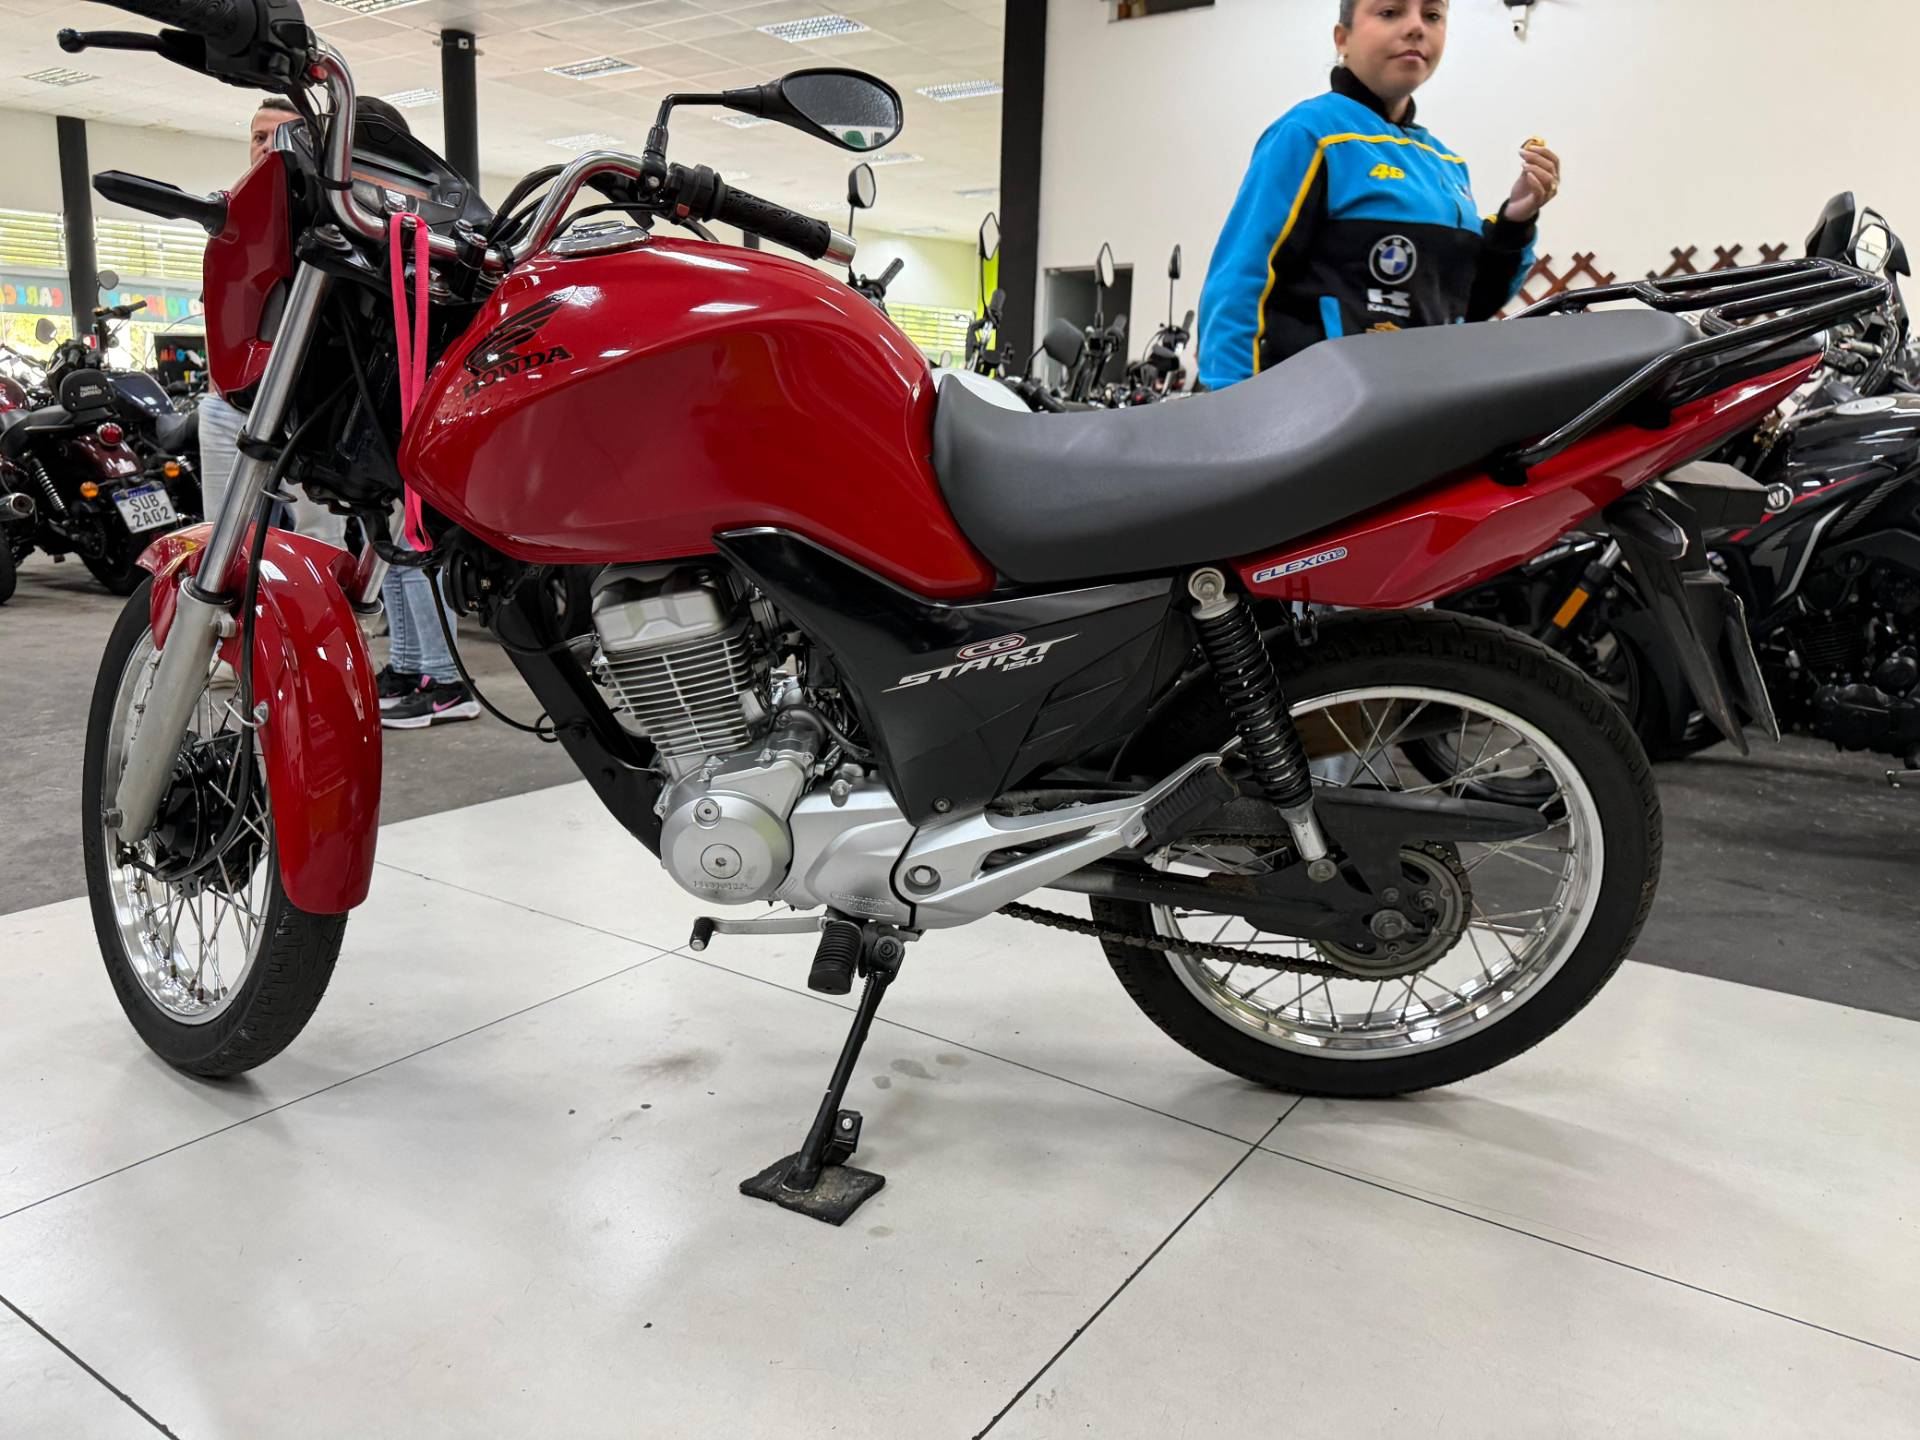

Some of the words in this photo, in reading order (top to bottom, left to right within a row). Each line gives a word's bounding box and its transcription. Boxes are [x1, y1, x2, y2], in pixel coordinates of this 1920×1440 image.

[462, 344, 573, 399] HONDA
[129, 494, 160, 513] SUB
[132, 506, 173, 528] 2A02
[962, 635, 1023, 658] CG
[884, 633, 1079, 692] START
[1001, 654, 1045, 672] 150
